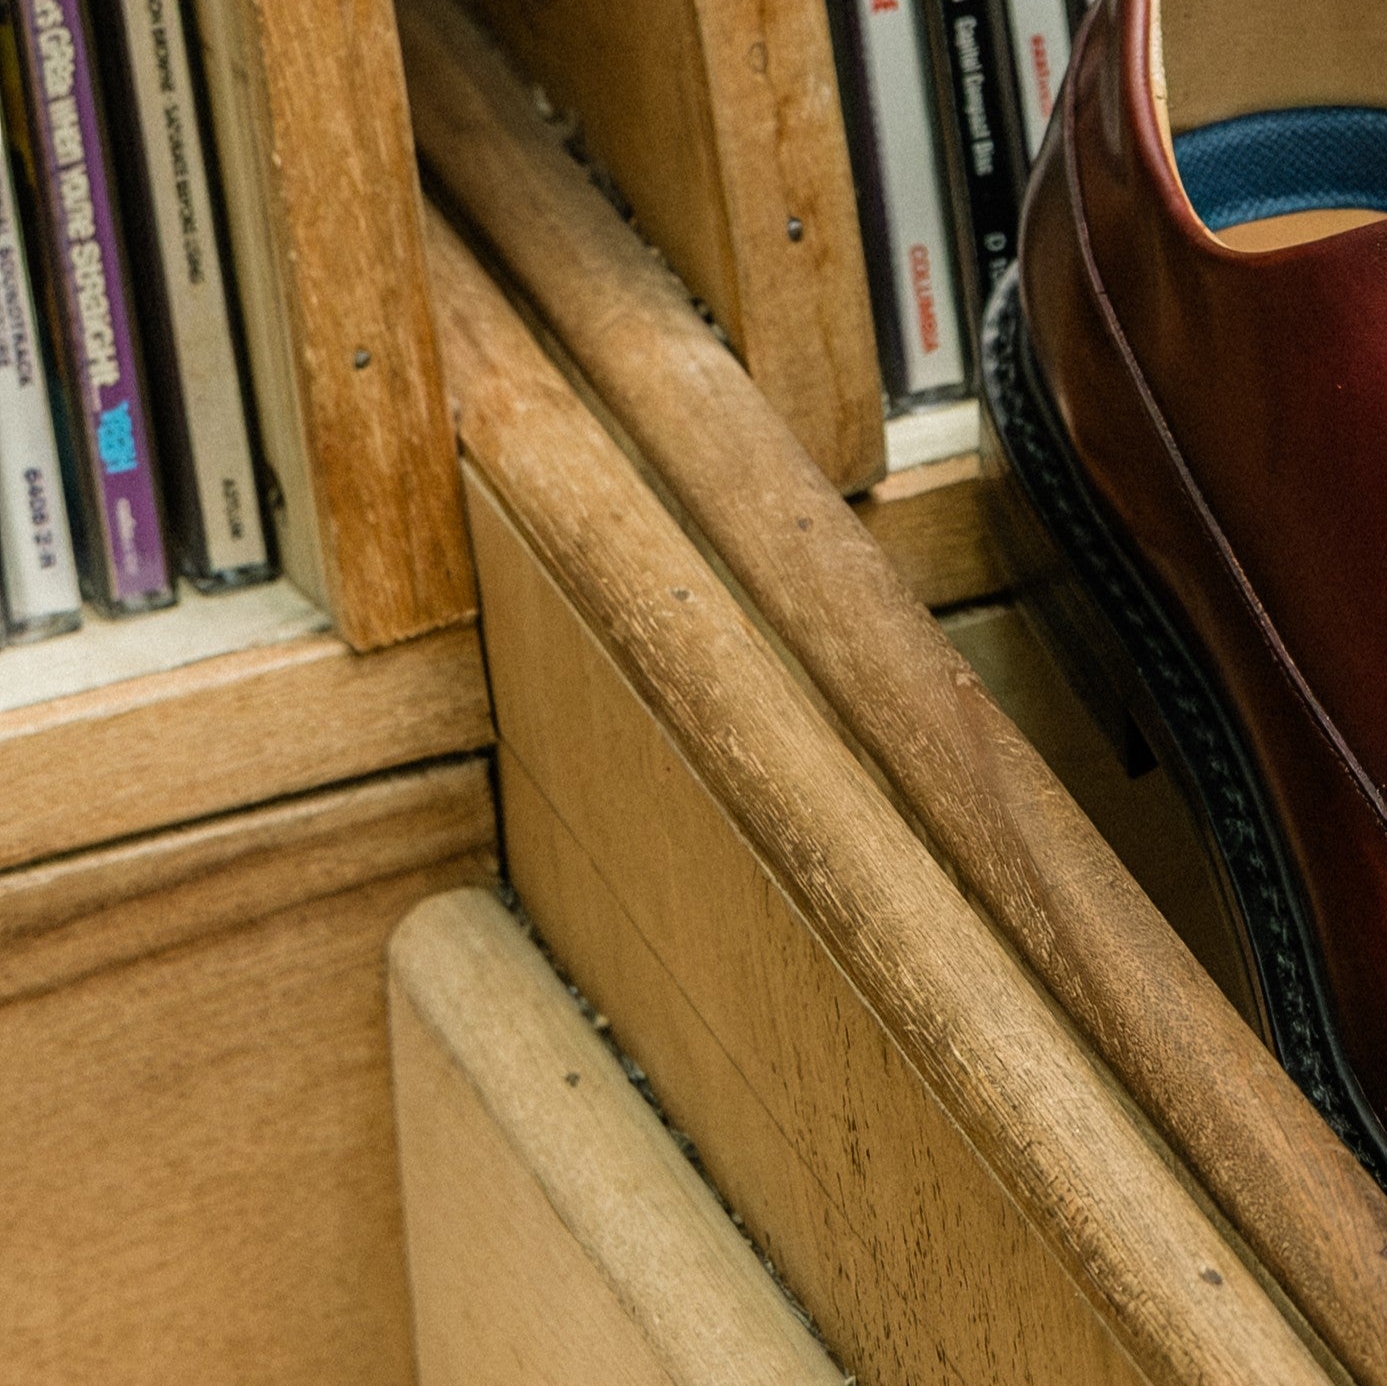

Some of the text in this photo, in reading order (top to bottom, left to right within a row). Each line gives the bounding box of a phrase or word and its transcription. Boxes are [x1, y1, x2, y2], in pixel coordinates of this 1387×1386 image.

[952, 14, 999, 177] Capitol Compact Disc
[906, 242, 942, 355] COLUMBIA
